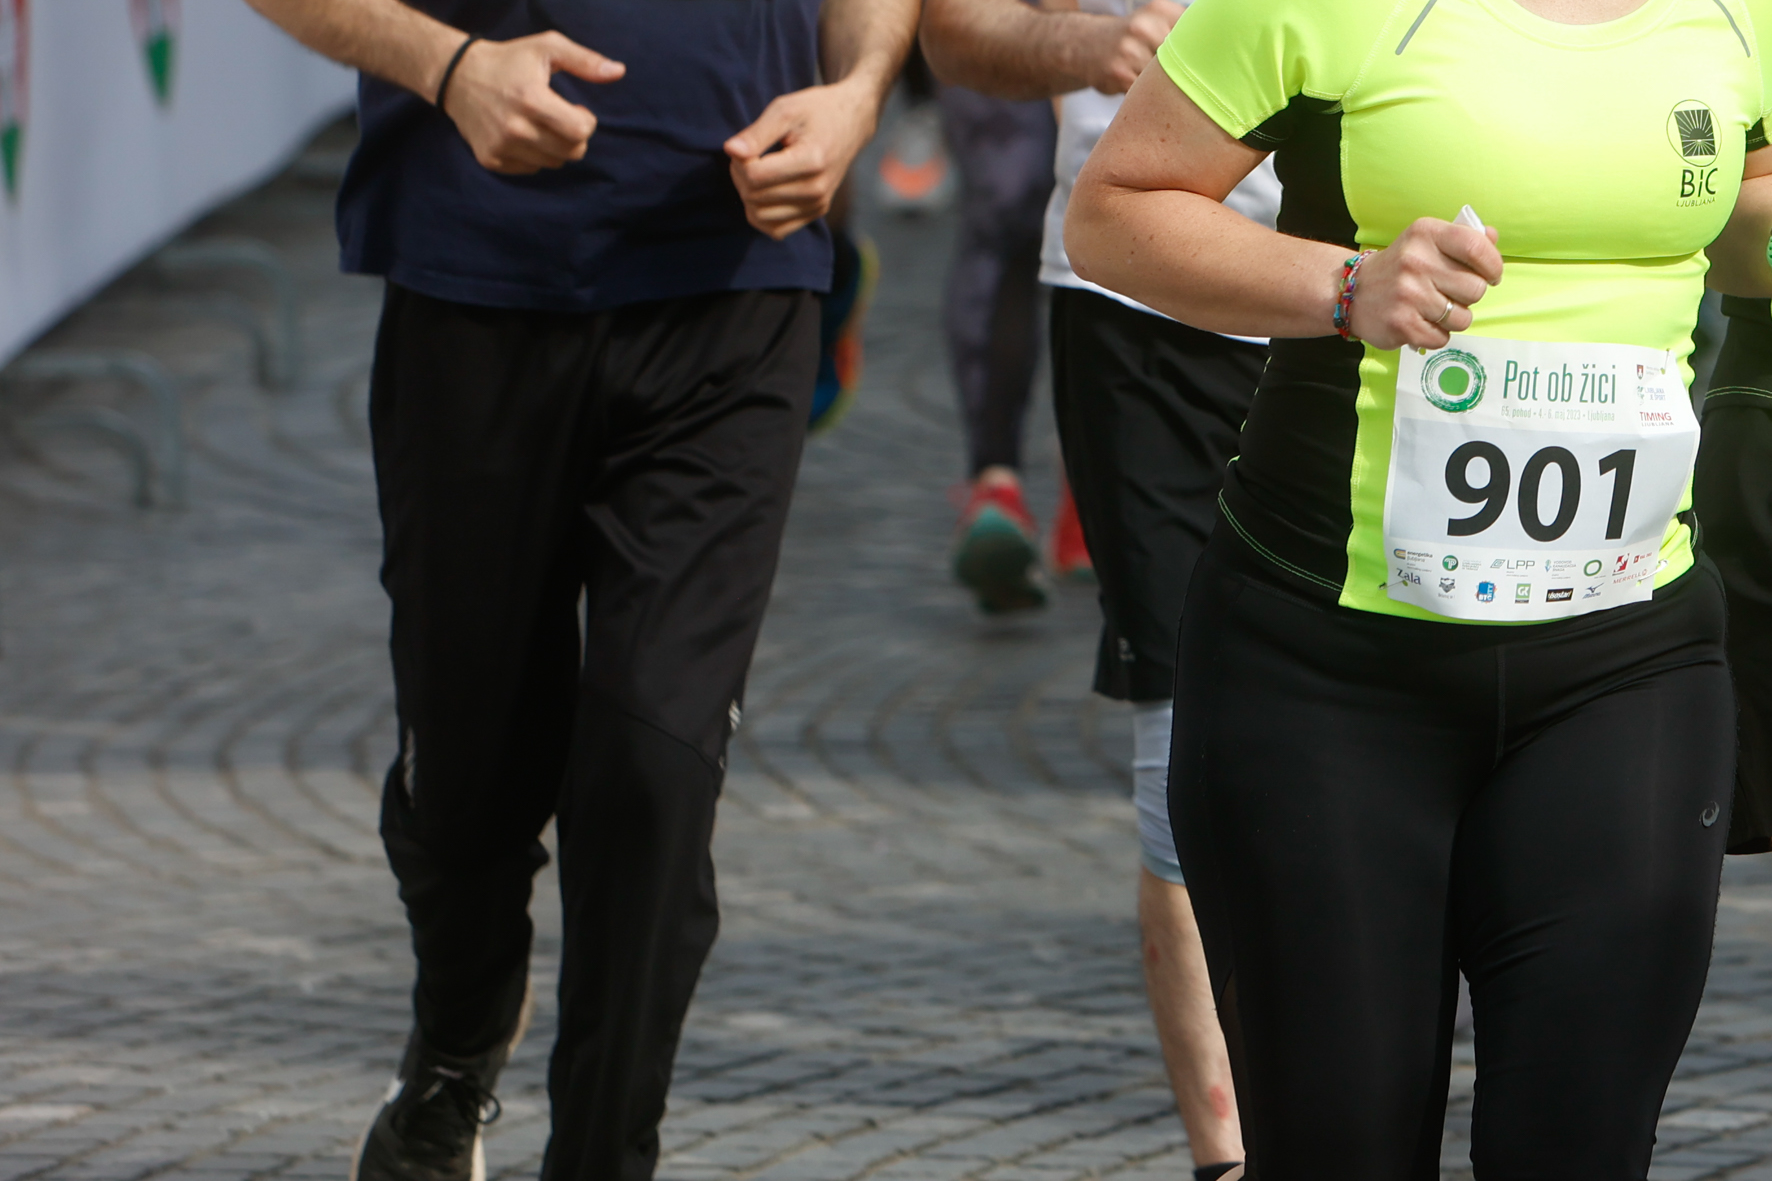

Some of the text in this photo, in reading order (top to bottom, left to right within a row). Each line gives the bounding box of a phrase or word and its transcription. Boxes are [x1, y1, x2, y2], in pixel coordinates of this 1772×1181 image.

[1676, 197, 1715, 207] LJUBLJANA
[1503, 360, 1616, 404] Pot ob žici
[1512, 407, 1532, 418] pohod
[1567, 410, 1580, 420] 2023
[1588, 410, 1615, 422] Ljubljana
[1640, 411, 1672, 421] TIMING
[1445, 440, 1636, 542] 901
[1407, 550, 1433, 558] energetika
[1507, 560, 1535, 570] LPP
[1396, 567, 1422, 586] Zala
[1613, 573, 1641, 584] MERRELL
